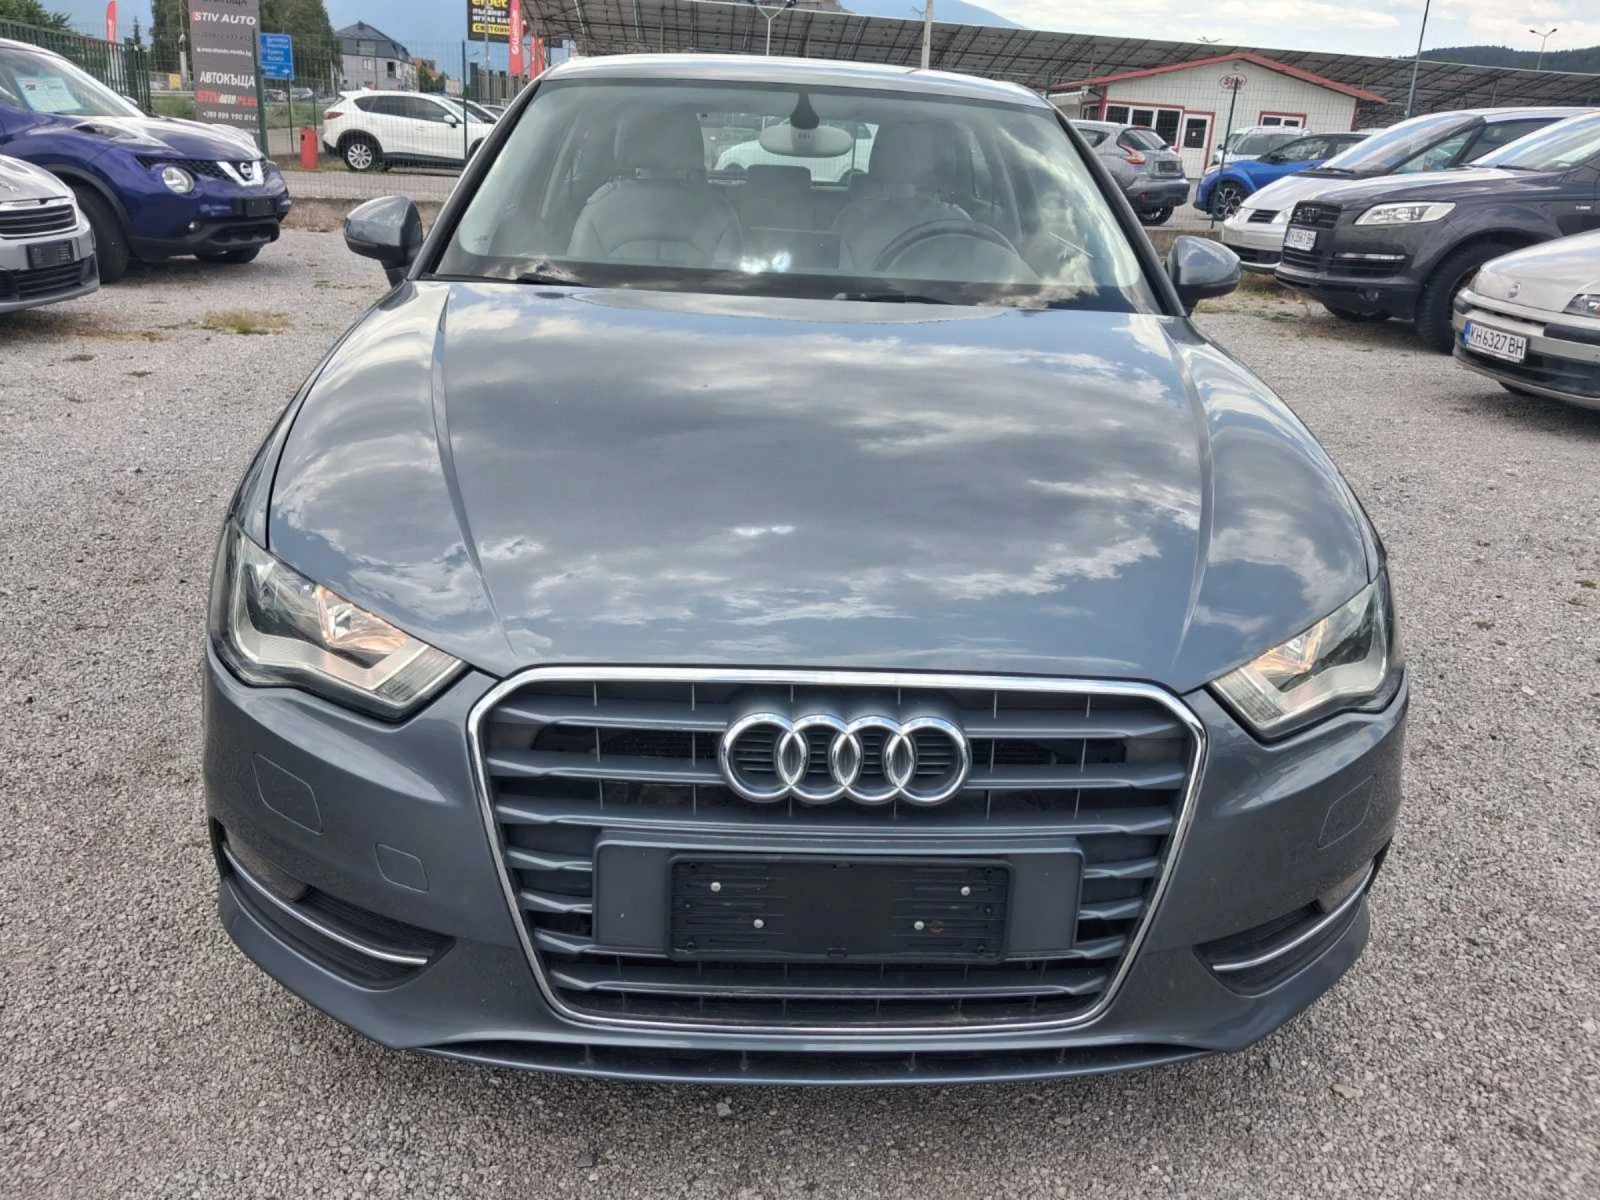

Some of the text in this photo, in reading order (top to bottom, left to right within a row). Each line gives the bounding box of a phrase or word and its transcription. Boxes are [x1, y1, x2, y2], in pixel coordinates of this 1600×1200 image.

[193, 11, 256, 25] STIV AUTO
[200, 71, 256, 89] АВТОКЪЩА
